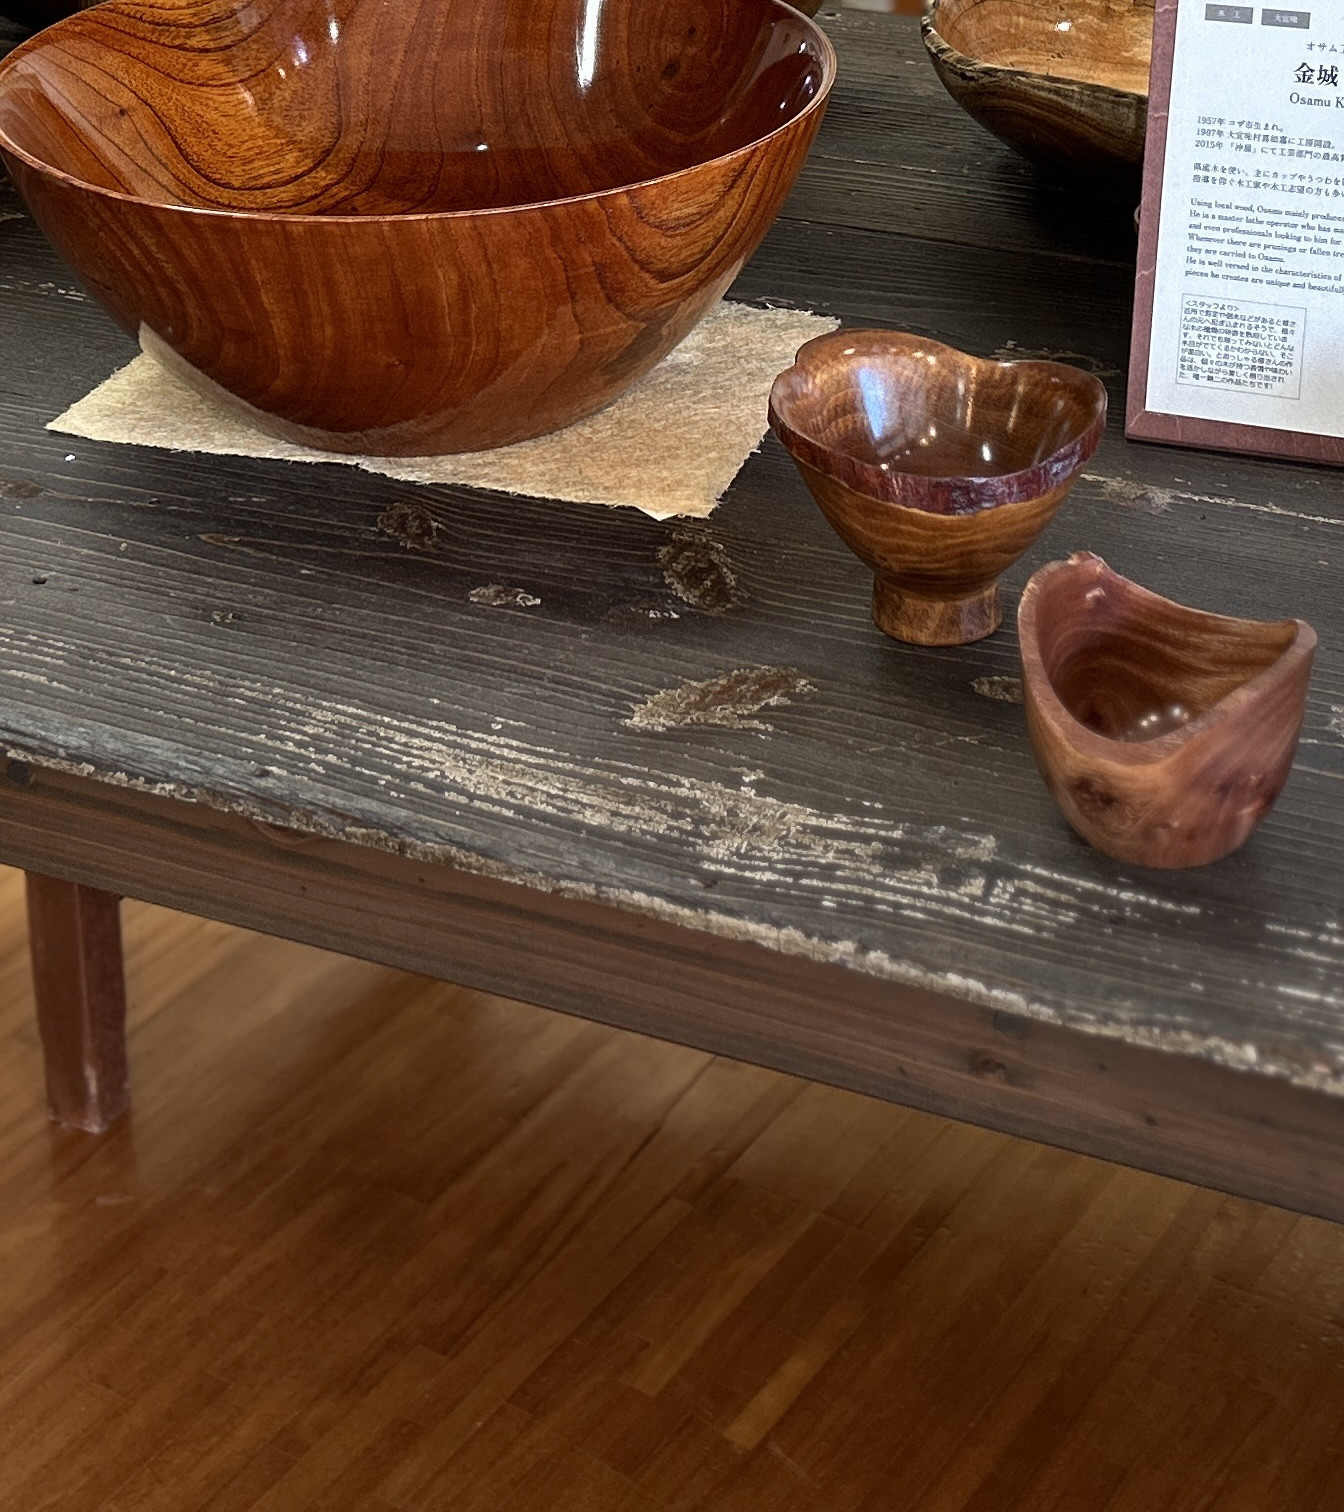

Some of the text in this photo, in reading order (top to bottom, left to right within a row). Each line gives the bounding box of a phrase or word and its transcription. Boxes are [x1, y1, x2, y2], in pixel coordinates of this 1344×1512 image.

[1293, 62, 1339, 87] 金城
[1290, 92, 1331, 107] Osamu
[1191, 198, 1212, 208] Using
[1215, 200, 1232, 209] local
[1257, 205, 1283, 215] Osamu
[1190, 209, 1200, 217] He
[1246, 216, 1264, 224] lathe
[1301, 222, 1316, 230] who
[1318, 224, 1331, 232] has
[1223, 226, 1272, 237] professionals
[1275, 231, 1302, 242] looking
[1314, 235, 1328, 244] him
[1330, 237, 1342, 245] for
[1187, 245, 1202, 254] they
[1219, 250, 1246, 258] carried
[1227, 238, 1247, 246] there
[1310, 247, 1330, 256] fallen
[1185, 268, 1208, 277] pieces
[1186, 256, 1196, 264] He
[1261, 265, 1273, 273] the
[1275, 267, 1332, 280] characteristics
